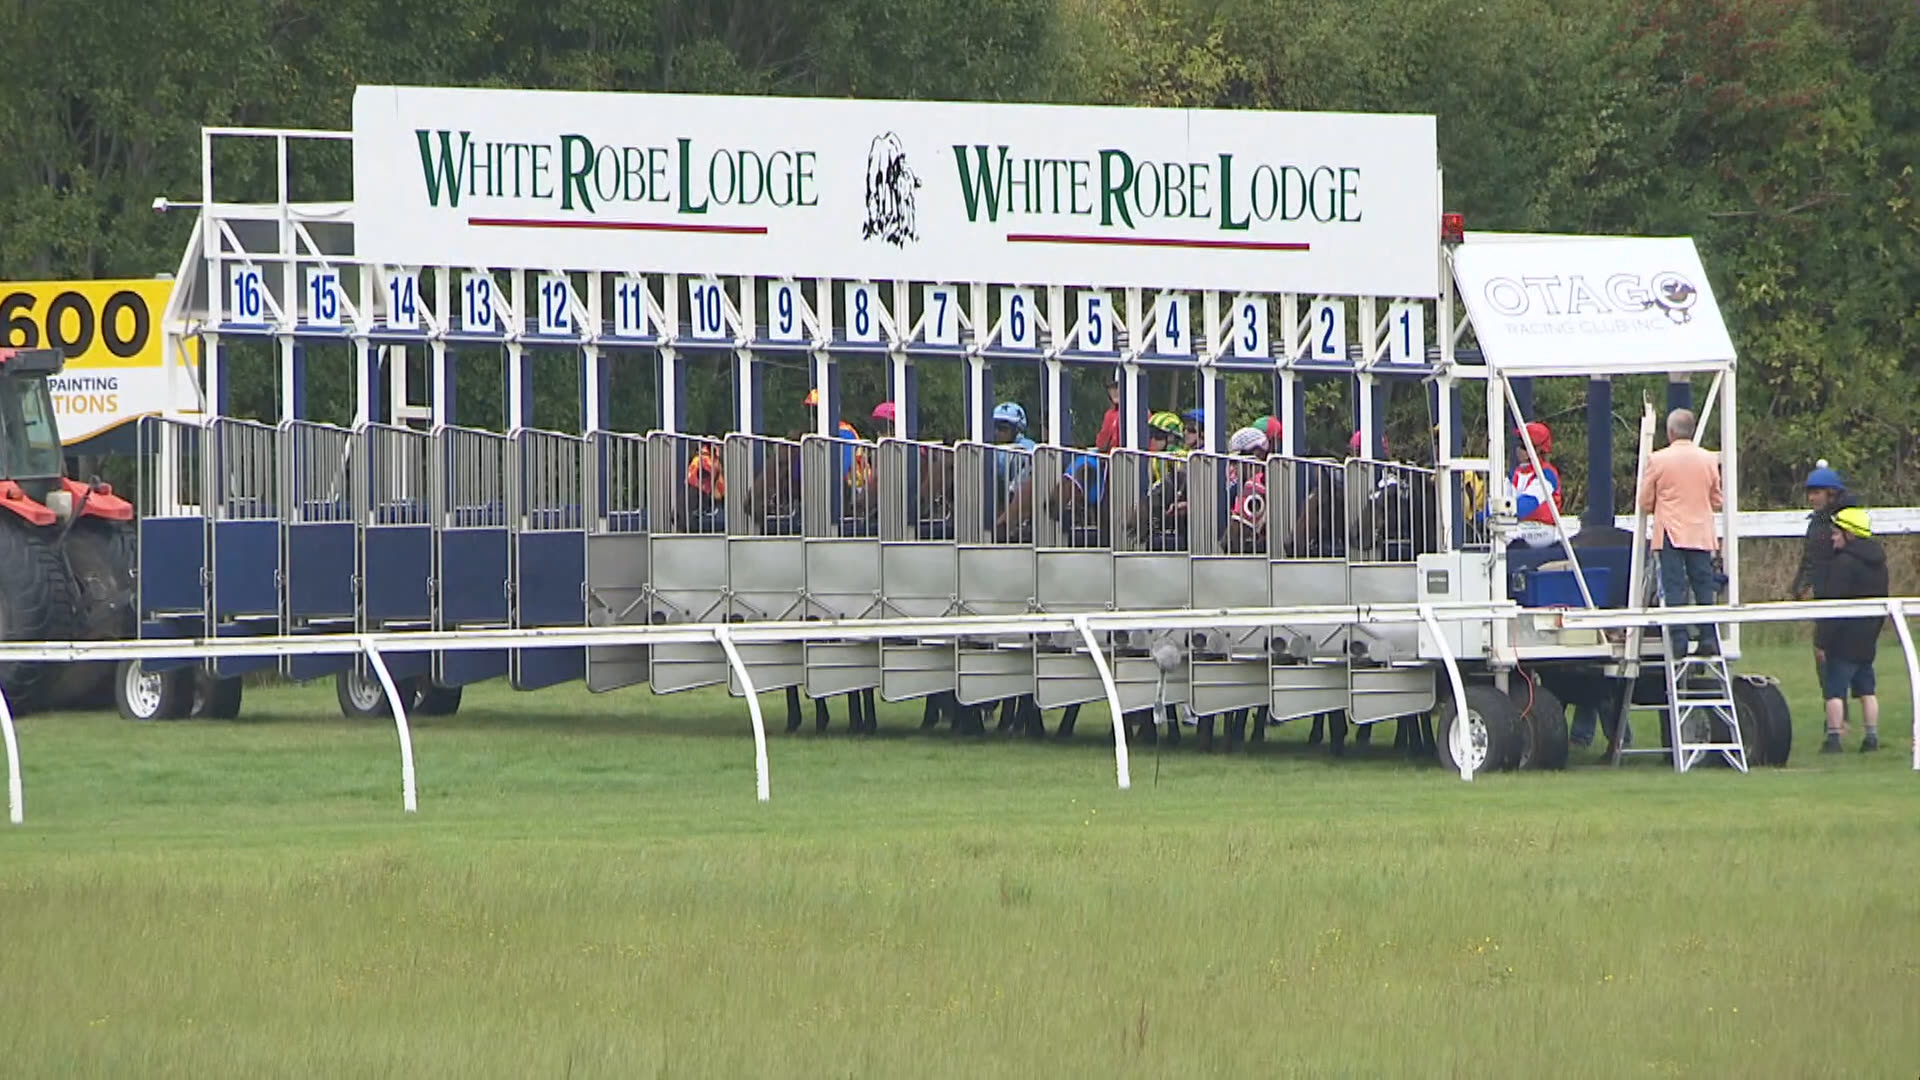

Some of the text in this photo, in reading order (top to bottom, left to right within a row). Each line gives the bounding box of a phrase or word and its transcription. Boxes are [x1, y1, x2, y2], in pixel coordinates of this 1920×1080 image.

[234, 271, 260, 317] 16
[310, 274, 337, 320] 15
[389, 276, 416, 323] 14
[465, 278, 491, 326] 13
[542, 281, 568, 328] 12
[618, 282, 642, 329] 11
[693, 285, 721, 332] 10
[778, 286, 793, 334] 9
[855, 288, 870, 336] 8
[933, 291, 948, 338] 7
[1484, 270, 1698, 317] OTAGO
[1010, 294, 1025, 342] 6
[1088, 298, 1102, 345] 5
[1165, 300, 1180, 348] 4
[1243, 303, 1258, 351] 3
[1320, 306, 1336, 354] 2
[1399, 309, 1411, 357] 1
[49, 376, 118, 392] PAINTING
[53, 394, 118, 414] TIONS
